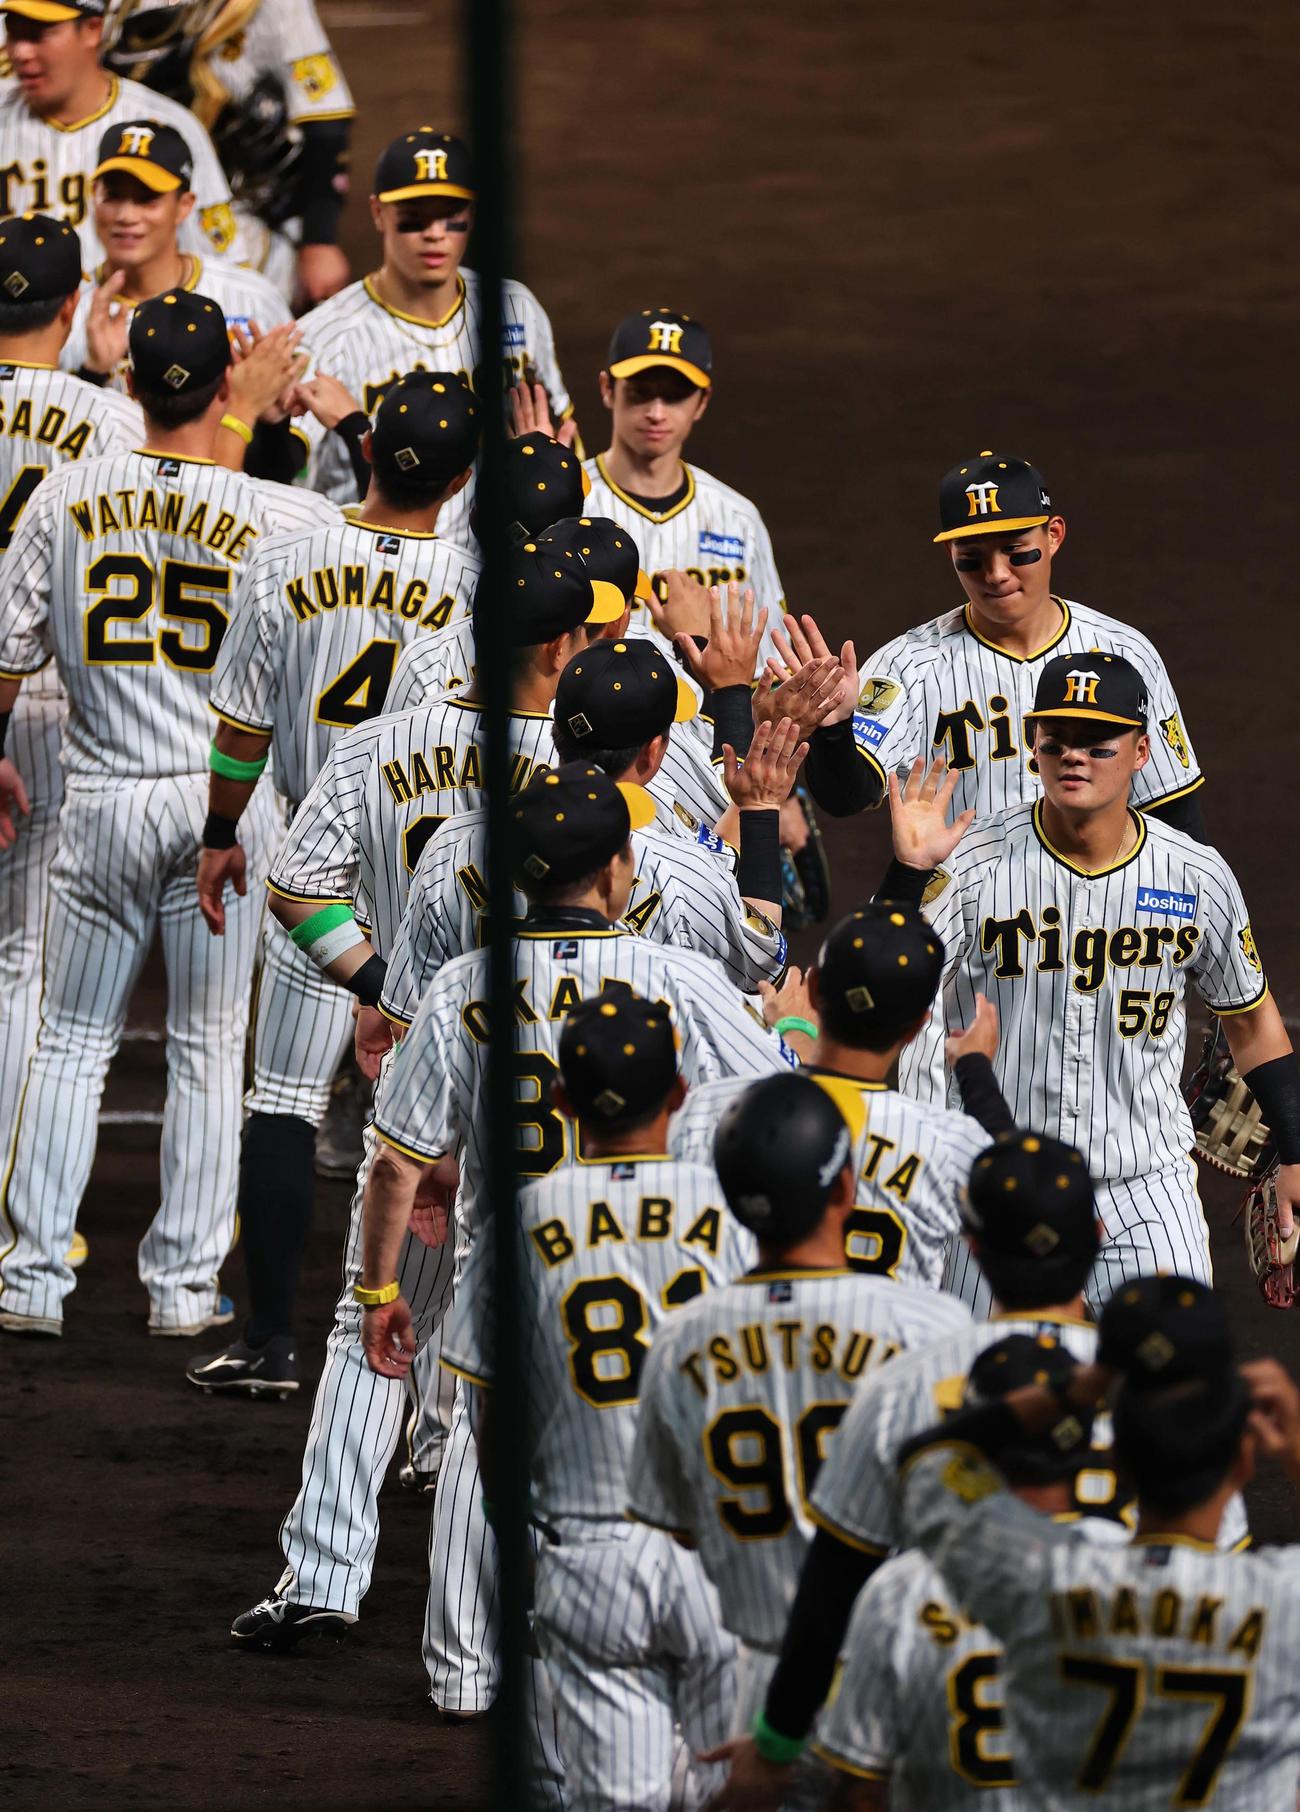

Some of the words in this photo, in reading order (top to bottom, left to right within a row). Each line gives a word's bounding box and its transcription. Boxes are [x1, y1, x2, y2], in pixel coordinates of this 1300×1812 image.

[68, 489, 258, 563] WATANABE
[83, 552, 233, 674] 25
[286, 565, 474, 632] KUMAGA
[315, 638, 400, 728] 4
[1138, 892, 1194, 914] Joshin
[981, 906, 1200, 993] Tigers
[462, 974, 672, 1044] OKA
[1117, 988, 1176, 1040] 58
[531, 1197, 723, 1269] BABA
[678, 1320, 904, 1398] TSUTSU
[1057, 1655, 1253, 1809] 77
